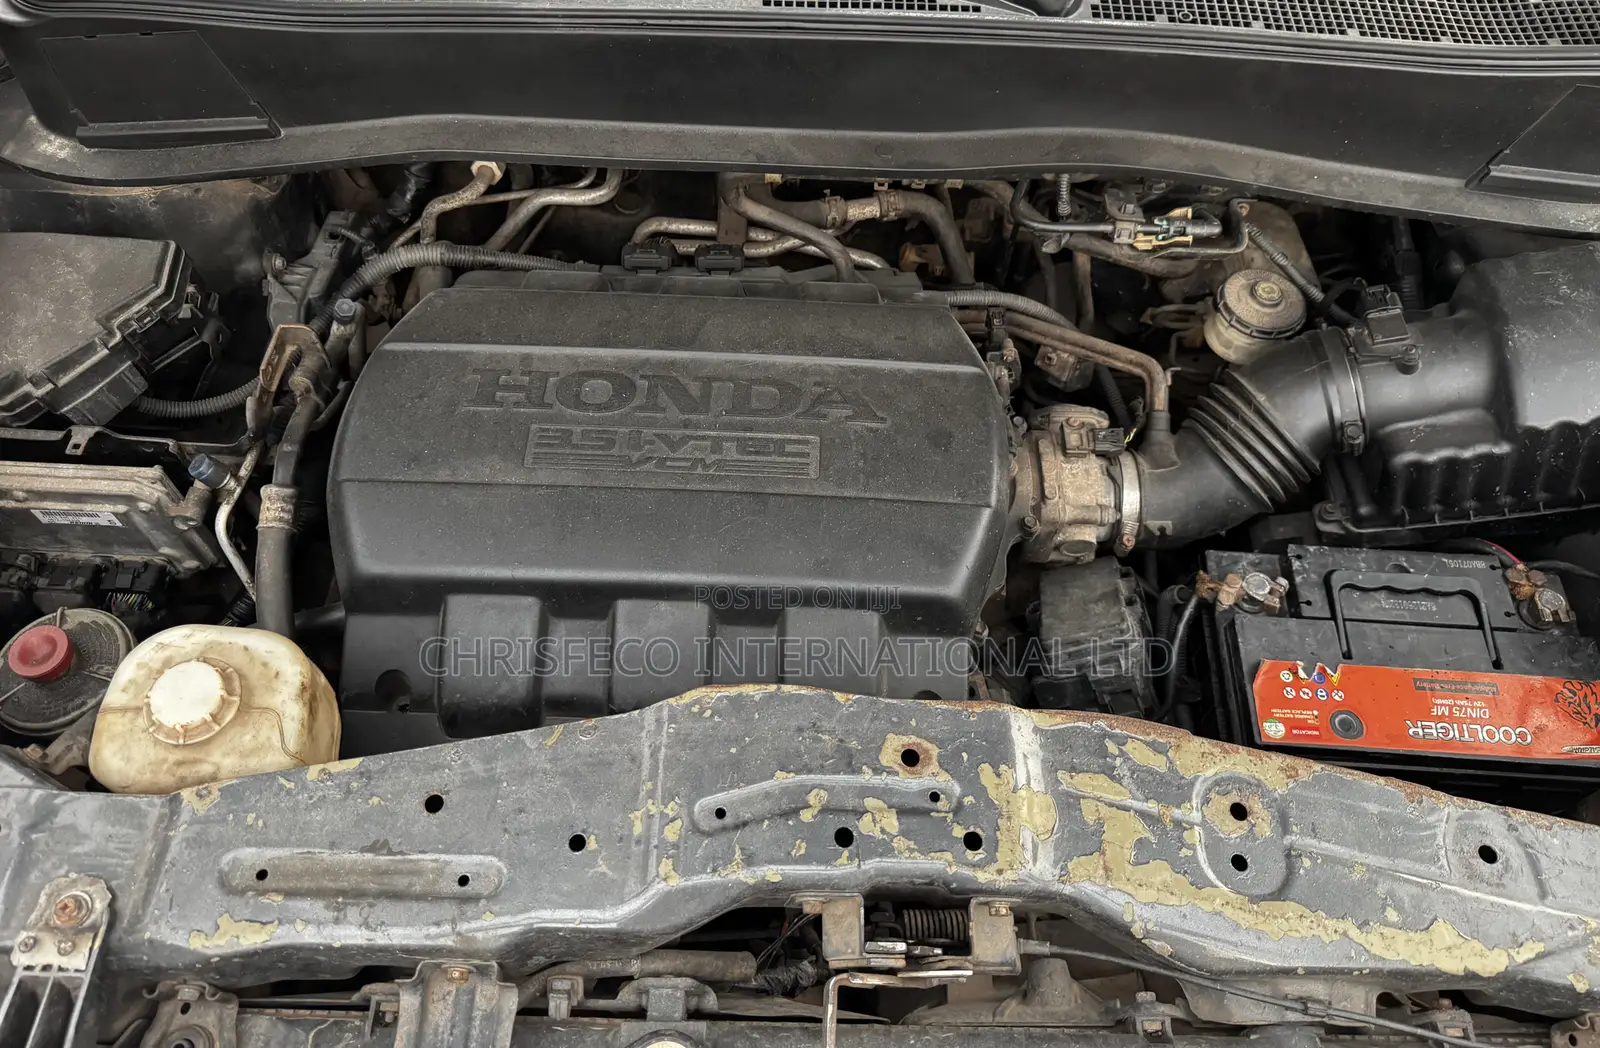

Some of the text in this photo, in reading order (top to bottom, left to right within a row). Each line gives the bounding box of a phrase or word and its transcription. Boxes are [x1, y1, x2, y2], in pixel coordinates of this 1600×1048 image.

[463, 369, 889, 426] HONDA
[1430, 705, 1490, 719] DIN75 MF
[1404, 720, 1532, 745] COOLTIGER
